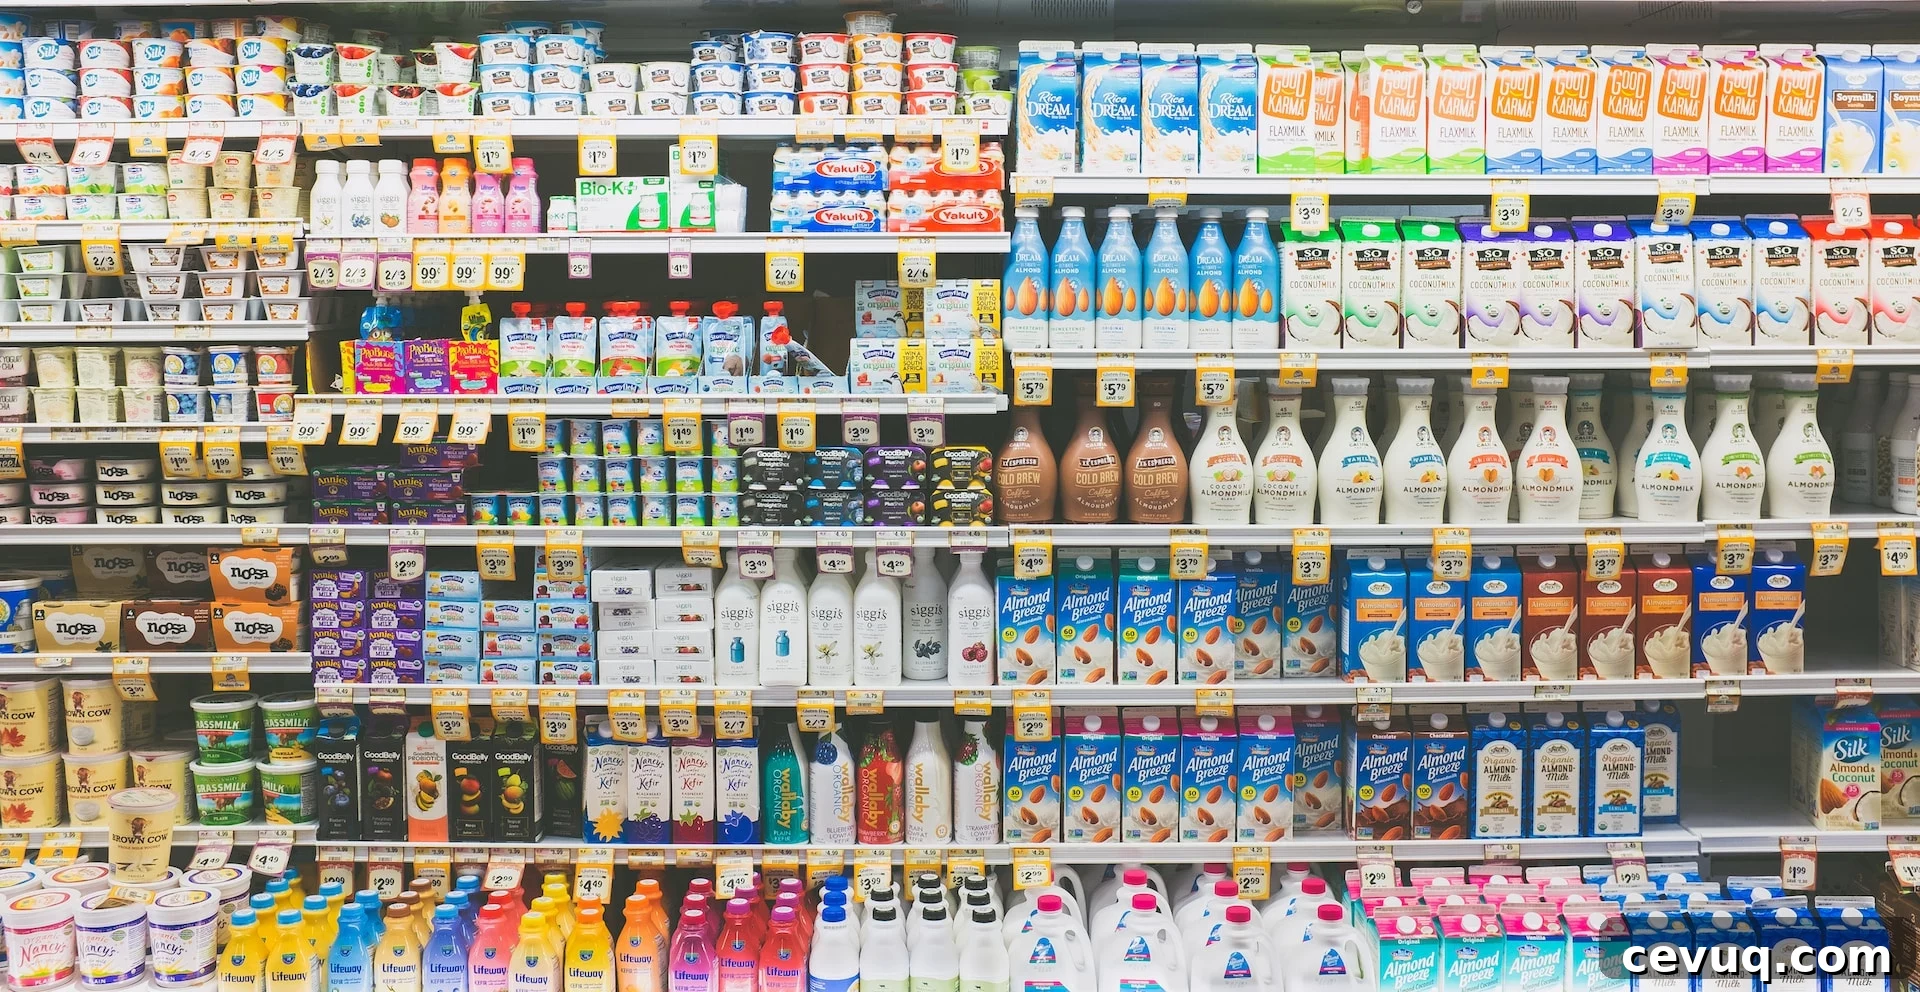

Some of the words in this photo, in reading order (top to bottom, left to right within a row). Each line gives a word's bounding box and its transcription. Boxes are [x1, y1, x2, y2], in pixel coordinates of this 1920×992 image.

[37, 43, 58, 57] Silk
[144, 44, 164, 59] Silk
[242, 42, 260, 56] Silk
[140, 73, 161, 88] Silk
[242, 66, 259, 84] Silk
[1270, 66, 1307, 98] GOOD
[1500, 70, 1533, 99] GOOD
[1612, 68, 1644, 98] GOOD
[1780, 68, 1814, 98] GOOD
[1038, 92, 1062, 103] Rice
[1103, 94, 1127, 104] Rice
[1220, 95, 1244, 104] Rice
[1836, 92, 1874, 103] Soymilk
[1028, 102, 1072, 117] DREAM
[1093, 103, 1137, 117] DREAM
[1209, 104, 1254, 118] DREAM
[1267, 98, 1308, 118] KARMA
[1495, 99, 1533, 117] KARMA
[1608, 96, 1643, 117] KARMA
[1779, 96, 1816, 117] KARMA
[1268, 125, 1306, 137] FLAXMILK
[1498, 128, 1533, 138] FLAXMILK
[1609, 127, 1644, 138] FLAXMILK
[1779, 126, 1814, 138] FLAXMILK
[825, 162, 866, 174] Yakult
[825, 212, 864, 222] Yakult
[1015, 253, 1040, 262] DREAM
[1102, 254, 1126, 263] DREAM
[1197, 256, 1221, 264] DREAM
[1363, 250, 1380, 258] SO
[1644, 274, 1690, 282] COCONUTMILK
[1290, 281, 1336, 289] COCONUTMILK
[1349, 281, 1396, 289] COCONUTMILK
[504, 384, 538, 396] Stonyfield
[555, 384, 589, 396] Stonyfield
[605, 384, 638, 396] Stonyfield
[757, 451, 792, 459] GoodBelly
[878, 449, 912, 458] GoodBelly
[1009, 458, 1037, 467] ESPRESSO
[100, 467, 128, 476] noosa
[393, 477, 424, 488] Annie's
[1134, 473, 1153, 485] COLD
[1155, 473, 1177, 484] BREW
[1145, 488, 1171, 498] Coffee
[1641, 484, 1694, 492] ALMONDMILK
[39, 490, 69, 501] noosa
[232, 568, 269, 580] noosa
[1002, 587, 1051, 614] Almond
[1122, 588, 1172, 614] Almond
[767, 600, 800, 614] siggi's
[911, 604, 943, 618] siggi's
[721, 607, 754, 622] siggi's
[1012, 603, 1046, 624] Breeze
[1132, 603, 1166, 624] Breeze
[147, 622, 187, 634] noosa
[1005, 630, 1014, 638] 60
[1833, 740, 1869, 760] Silk
[318, 752, 354, 761] GoodBelly
[451, 752, 489, 762] GoodBelly
[595, 756, 624, 768] Nancy's
[1008, 749, 1056, 772] Almond
[1360, 748, 1407, 771] Almond
[1540, 755, 1574, 765] Organic
[678, 757, 708, 769] Nancy's
[1830, 763, 1869, 773] Almond
[1019, 763, 1053, 782] Breeze
[1370, 762, 1403, 781] Breeze
[1546, 772, 1568, 781] Milk
[597, 776, 620, 788] Kefir
[680, 778, 703, 789] Kefir
[1832, 773, 1875, 783] Coconut
[196, 783, 247, 793] GRASSMILK
[773, 769, 783, 818] ORGANIC
[778, 768, 797, 829] wallaby
[867, 768, 885, 830] wallaby
[113, 834, 145, 844] BROWN
[147, 832, 168, 843] COW
[21, 943, 65, 966] Nancy's
[330, 963, 362, 975] Lifeway
[1449, 952, 1499, 978] Almond
[272, 971, 307, 982] Lifeway
[569, 968, 603, 980] Lifeway
[674, 970, 708, 981] Lifeway
[1460, 967, 1494, 987] Breeze
